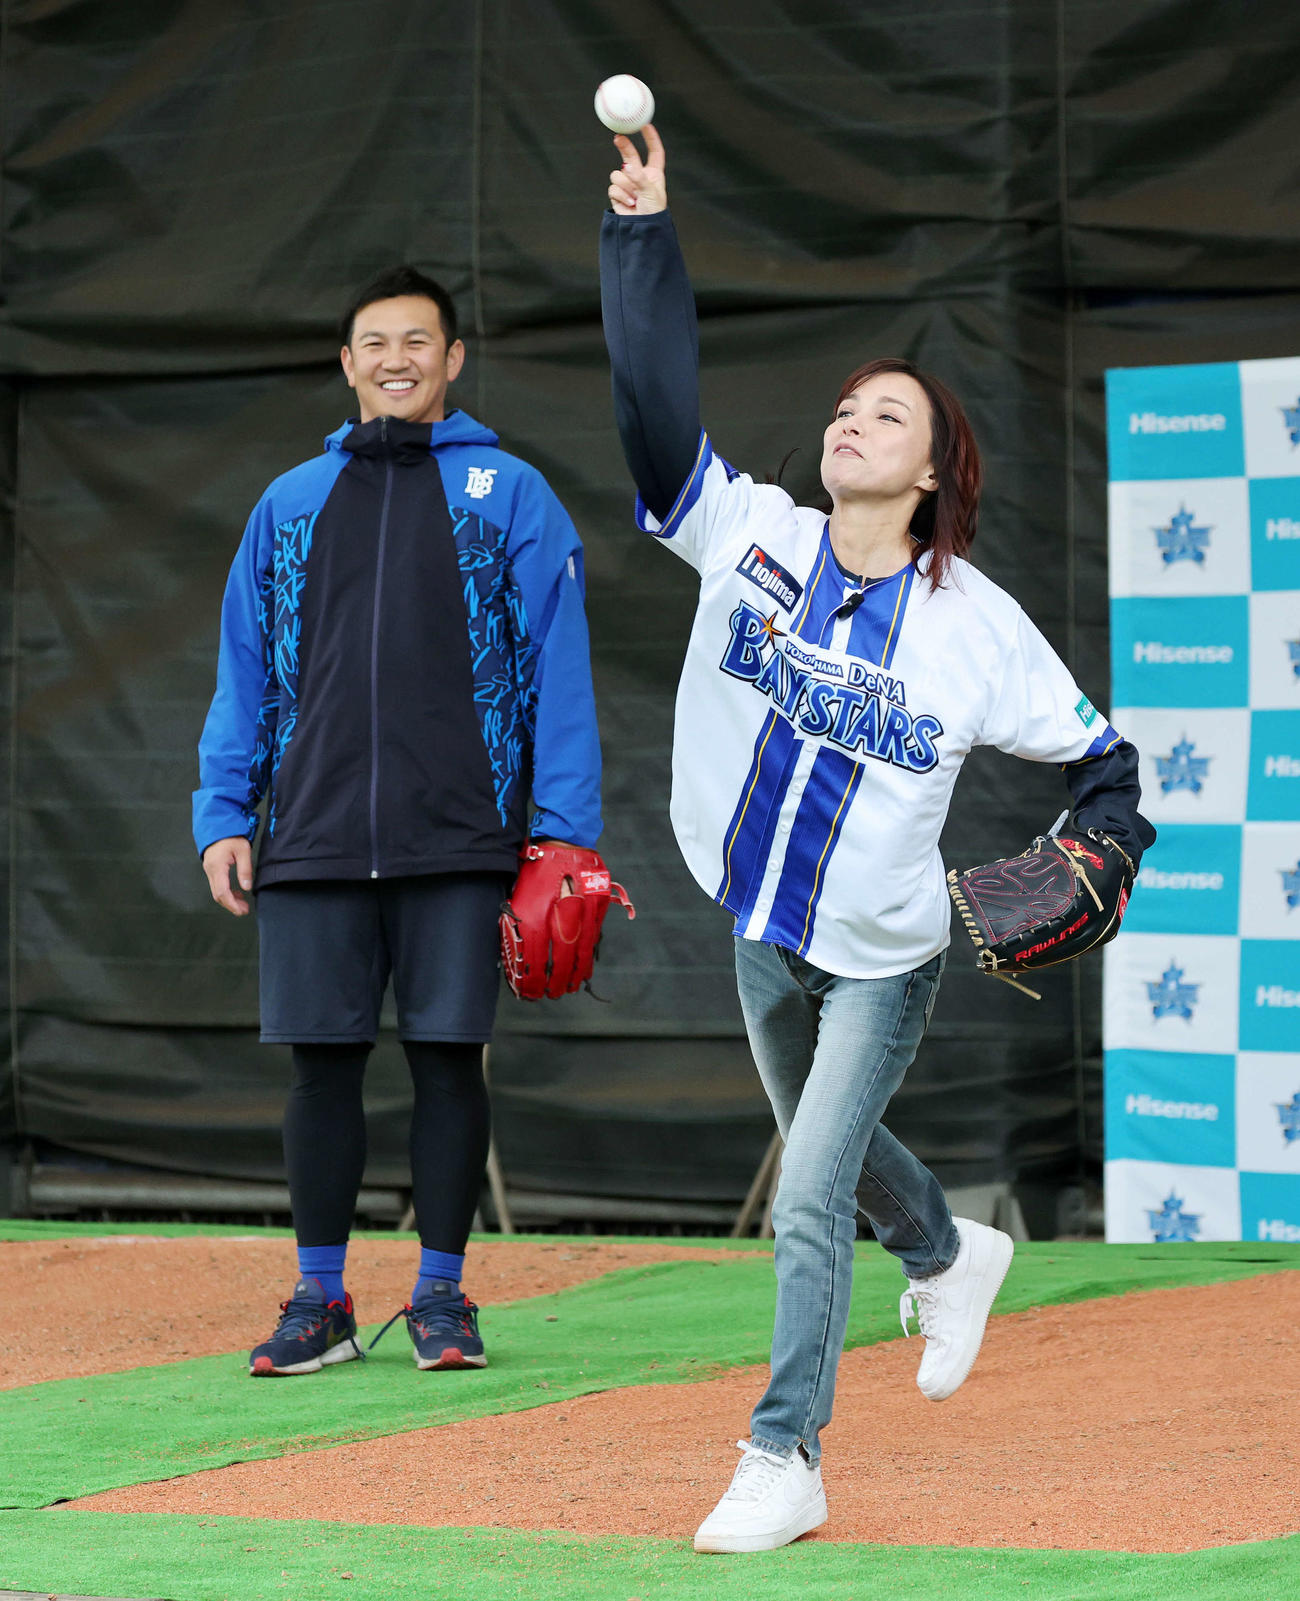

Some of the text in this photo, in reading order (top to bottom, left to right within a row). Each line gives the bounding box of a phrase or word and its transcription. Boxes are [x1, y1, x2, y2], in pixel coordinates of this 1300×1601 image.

[1128, 412, 1227, 434] Hisense
[785, 640, 844, 678] YOKOHAMA
[1133, 641, 1234, 663] Hisense
[719, 598, 944, 774] BAYSTARS
[847, 662, 906, 706] DeNA
[1014, 911, 1089, 963] RAWLINGS
[1125, 1094, 1219, 1121] Hisense
[1258, 1218, 1300, 1242] His
